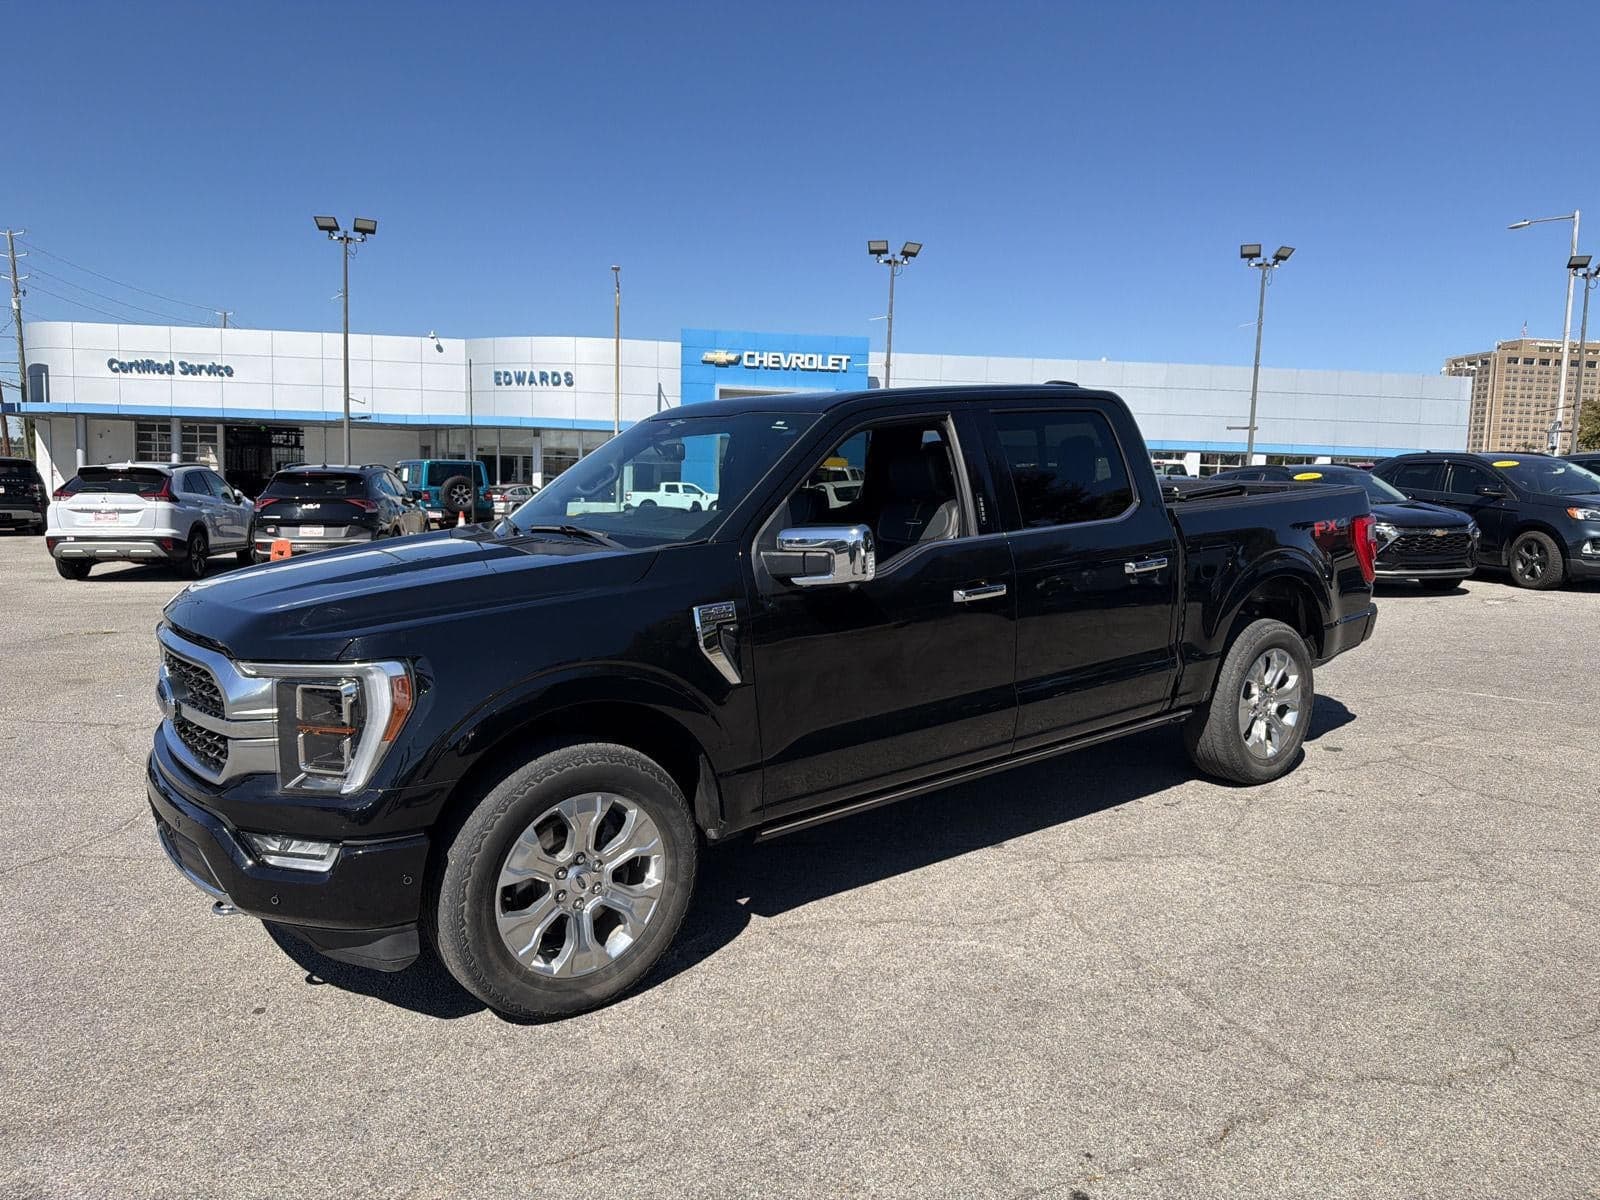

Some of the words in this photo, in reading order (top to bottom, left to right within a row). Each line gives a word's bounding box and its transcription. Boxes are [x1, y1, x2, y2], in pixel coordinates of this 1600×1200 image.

[107, 358, 175, 375] Certified
[178, 361, 234, 377] Service
[742, 352, 851, 371] CHEVROLET
[494, 371, 574, 387] EDWARDS
